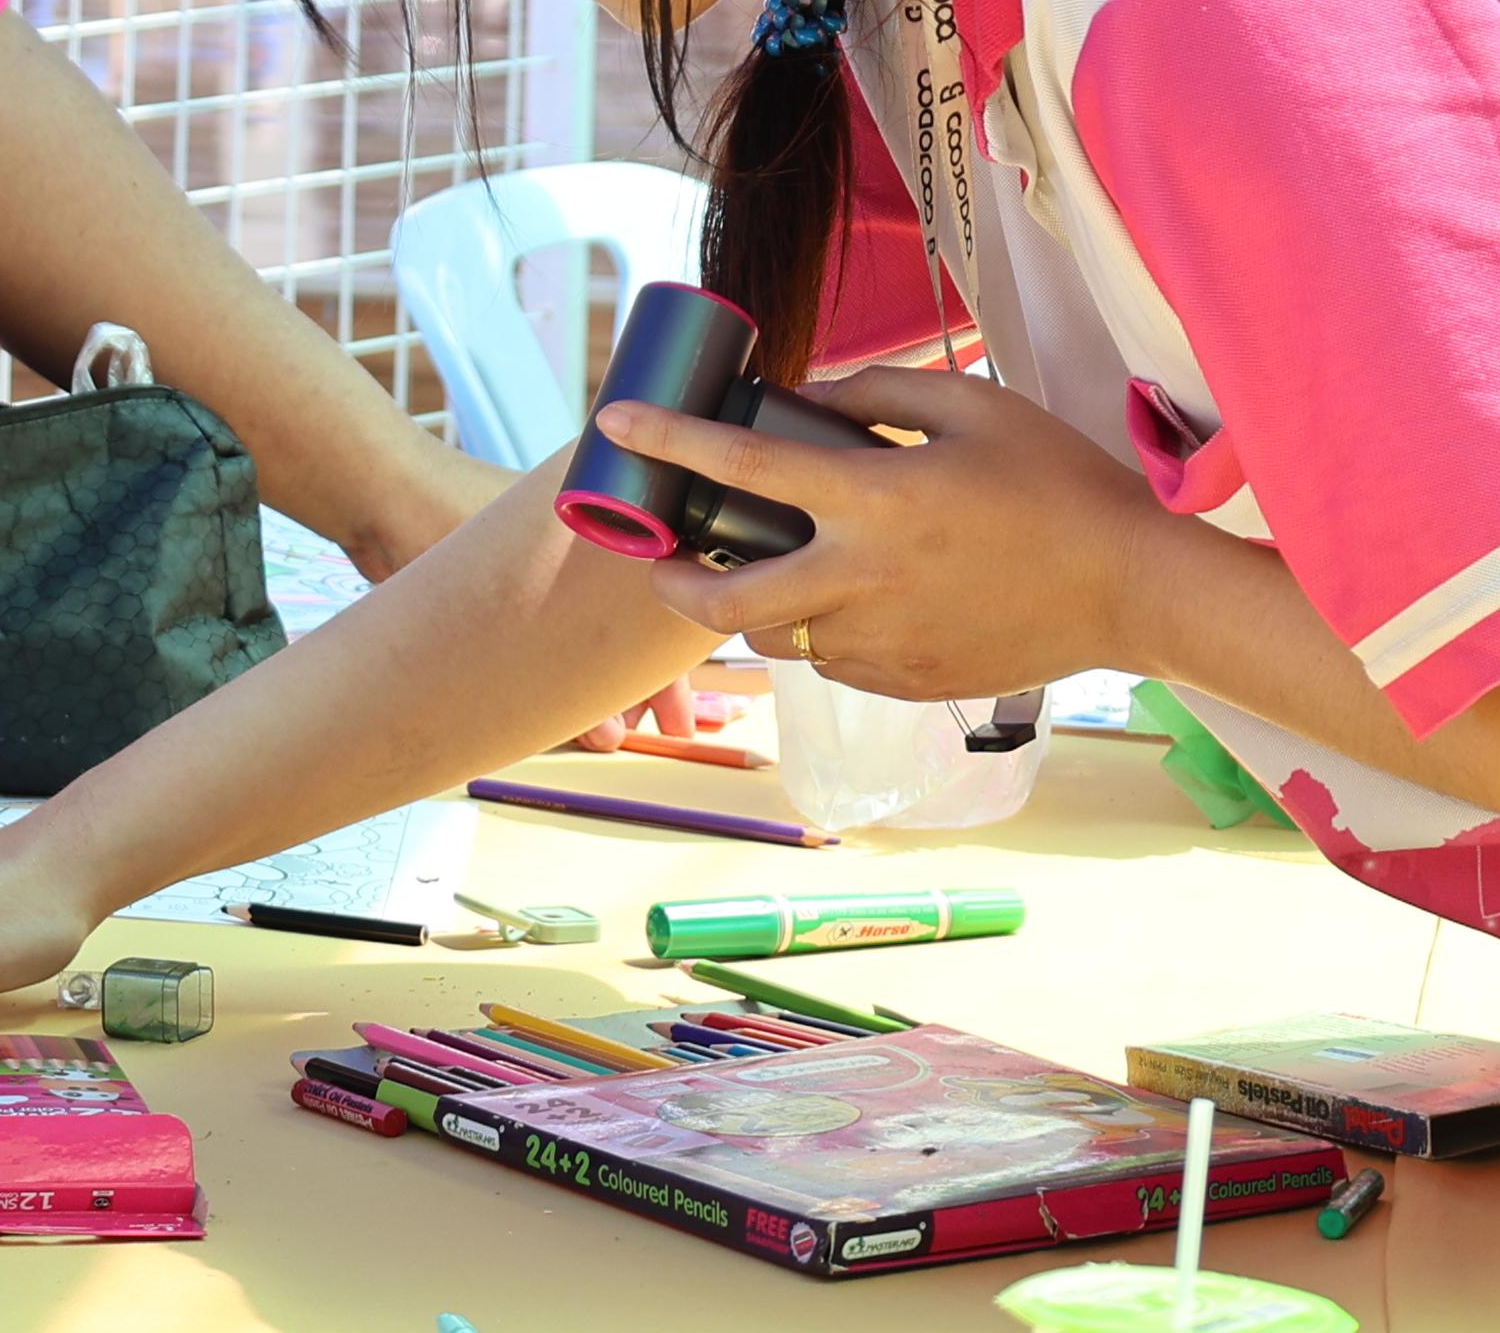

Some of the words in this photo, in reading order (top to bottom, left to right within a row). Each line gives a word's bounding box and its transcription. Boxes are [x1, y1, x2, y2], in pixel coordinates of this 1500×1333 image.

[855, 923, 911, 939] Horse
[1237, 1078, 1303, 1116] Pastels
[1304, 1092, 1331, 1121] Oil
[525, 1134, 591, 1186] 24+2
[598, 1164, 669, 1207] Coloured
[674, 1189, 729, 1228] Pencils
[1208, 1174, 1276, 1200] Coloured
[1281, 1166, 1333, 1190] Pencils
[19, 1191, 56, 1211] 12
[744, 1207, 791, 1241] FREE
